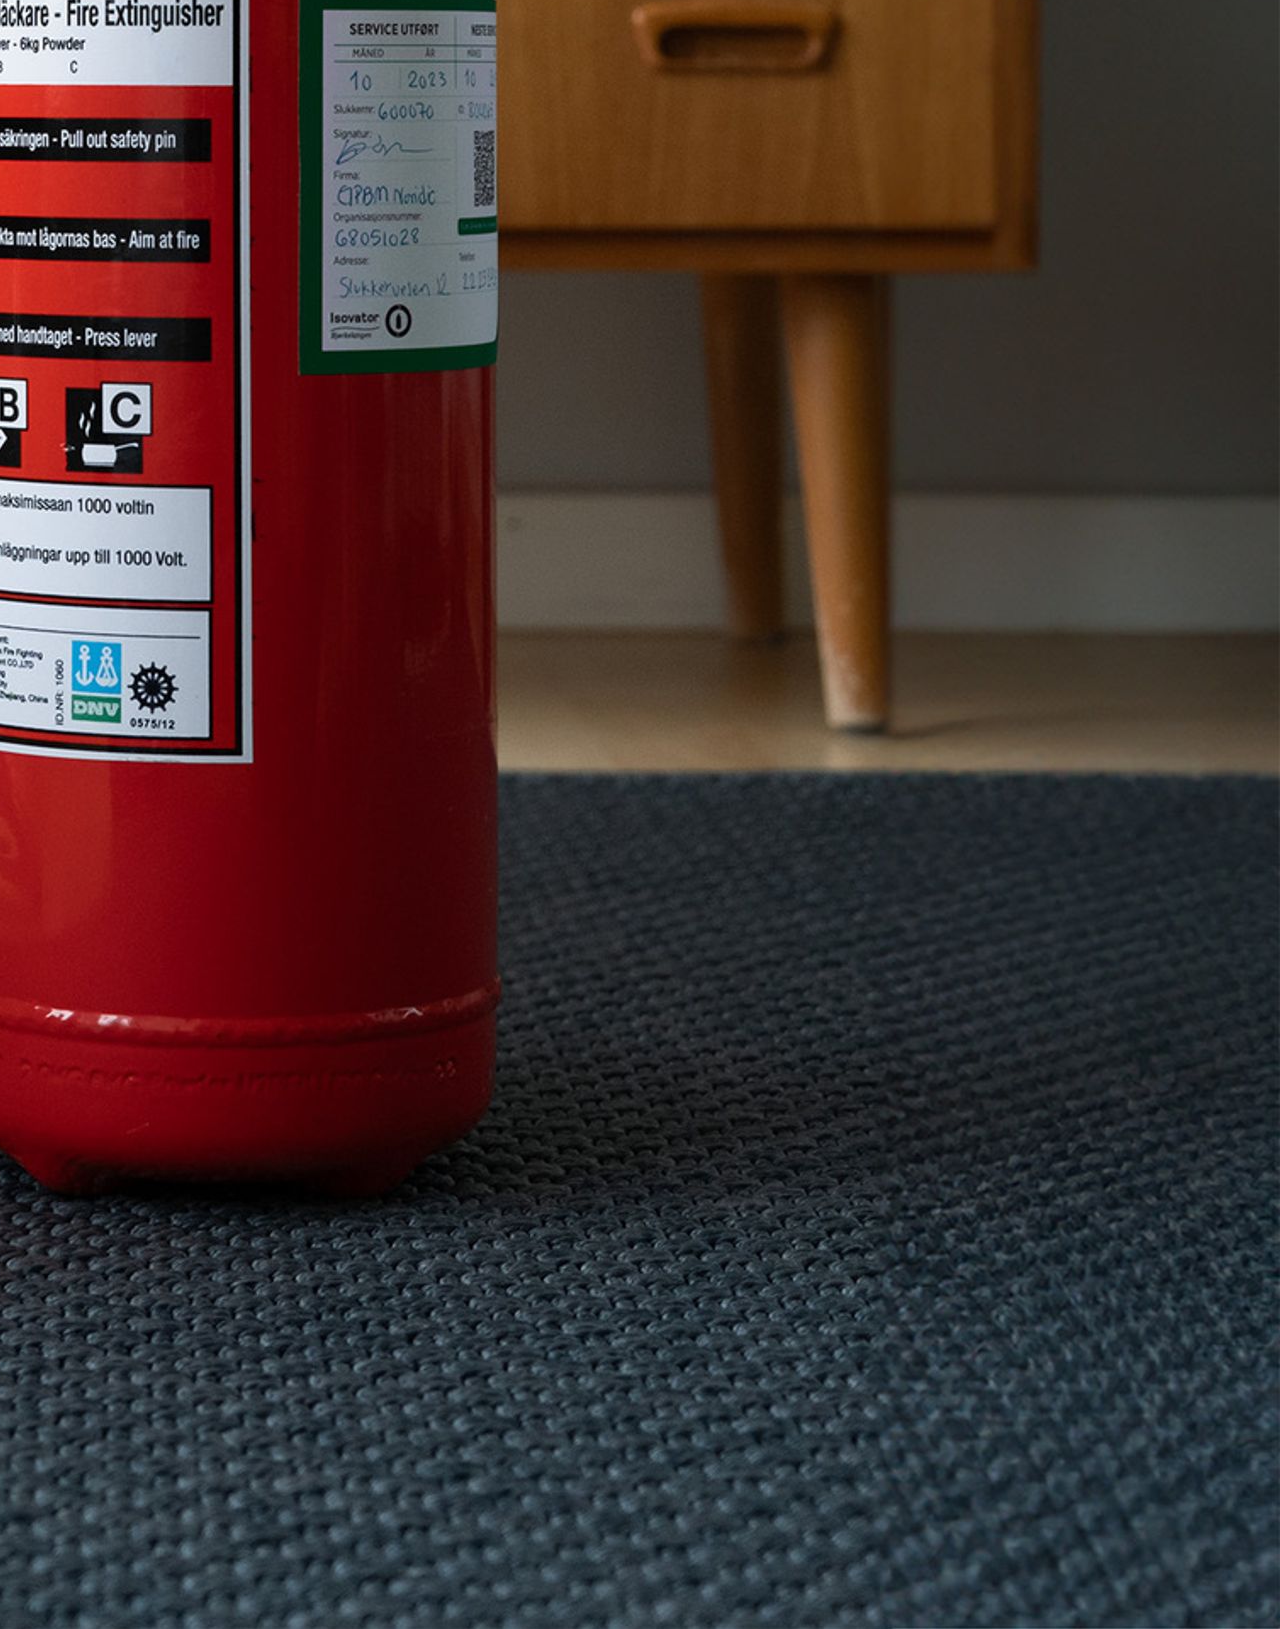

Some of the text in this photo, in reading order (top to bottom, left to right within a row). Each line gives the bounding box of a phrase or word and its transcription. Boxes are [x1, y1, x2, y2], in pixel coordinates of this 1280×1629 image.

[349, 23, 398, 35] SERVICE
[20, 37, 39, 53] 6kg
[42, 37, 86, 50] Powder
[352, 47, 384, 58] MÅNED
[69, 60, 78, 74] C
[350, 69, 448, 91] 10 2023
[0, 128, 49, 151] säkringen
[60, 129, 83, 148] Pull
[86, 130, 107, 148] out
[110, 129, 151, 152] safety
[154, 130, 176, 152] pin
[16, 229, 37, 246] mot
[39, 226, 89, 251] lågornas
[93, 229, 116, 248] bas
[128, 230, 155, 249] Aim
[159, 231, 173, 249] at
[176, 230, 200, 249] fire
[330, 312, 380, 324] Isovator
[17, 324, 72, 349] handtaget
[85, 327, 120, 347] Press
[124, 328, 157, 347] lever
[0, 387, 19, 422] B
[110, 391, 141, 428] C
[78, 498, 111, 513] 1000
[116, 500, 154, 515] voltin
[66, 550, 90, 566] upp
[94, 550, 110, 564] till
[116, 550, 152, 566] 1000
[156, 551, 187, 566] Volt.
[73, 700, 119, 717] DNV
[130, 717, 175, 730] 0575/12
